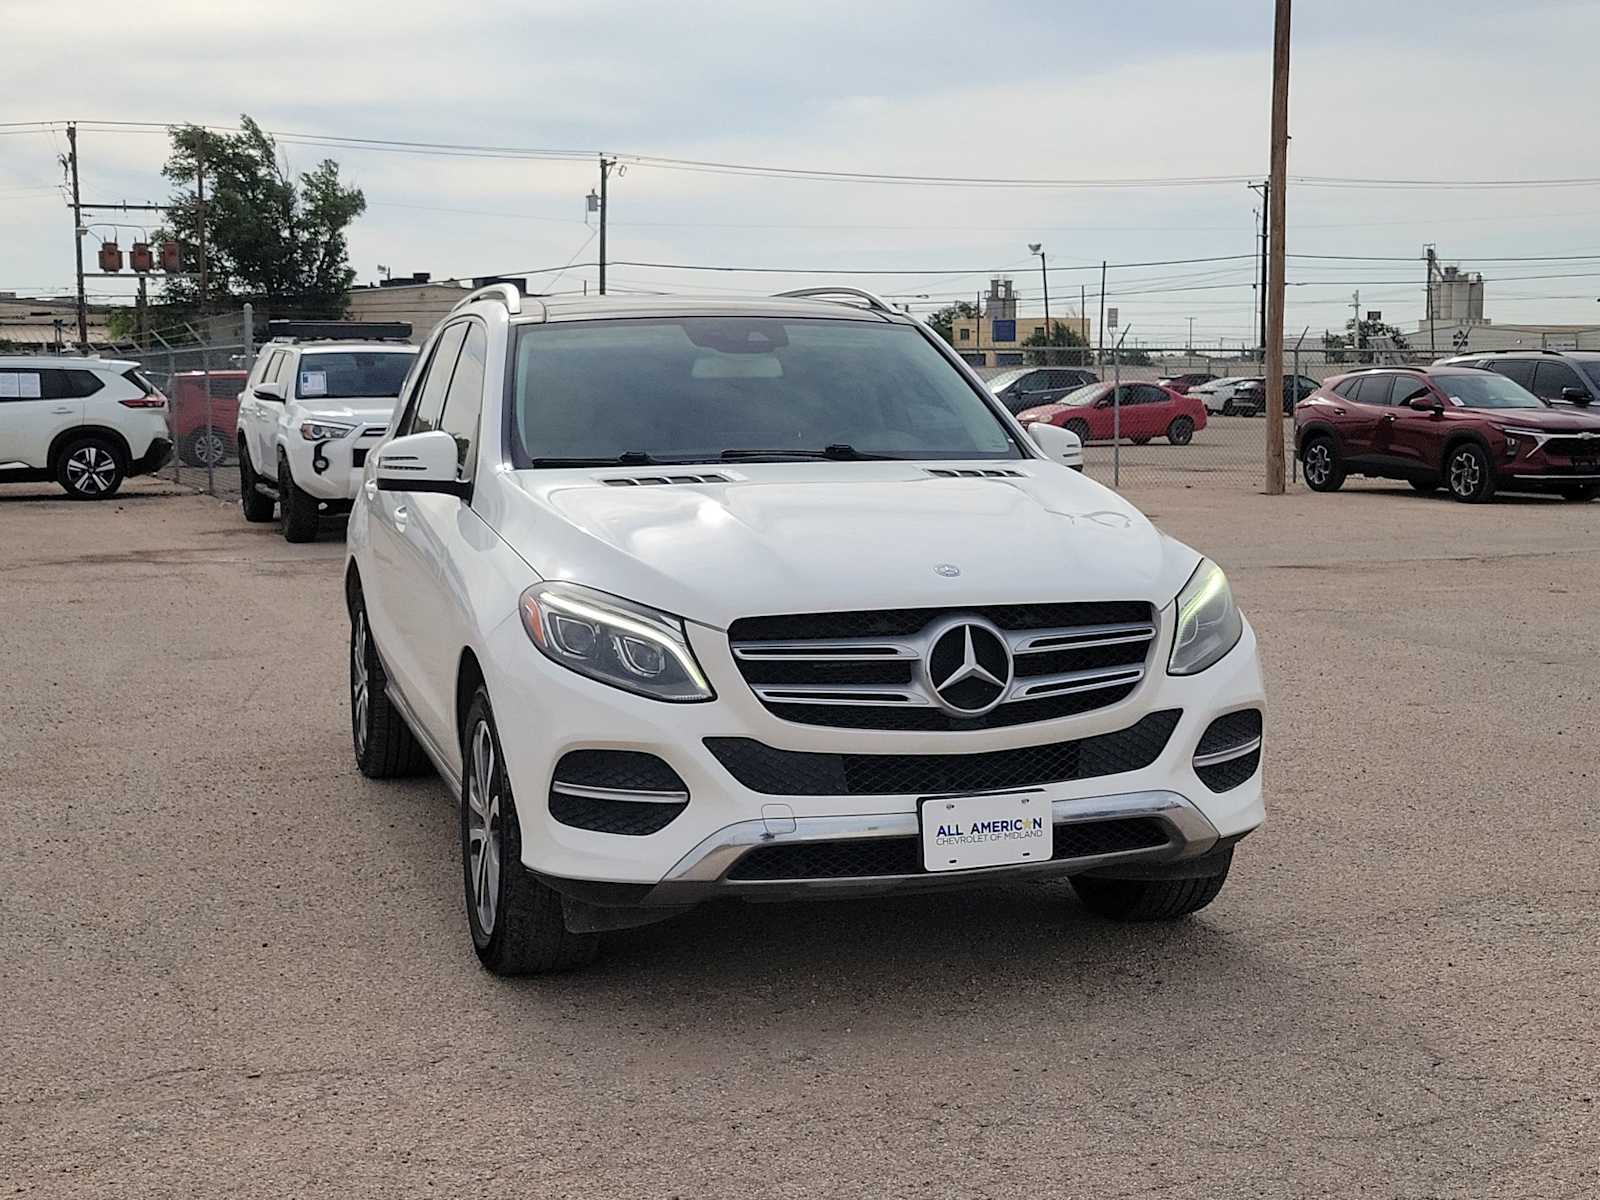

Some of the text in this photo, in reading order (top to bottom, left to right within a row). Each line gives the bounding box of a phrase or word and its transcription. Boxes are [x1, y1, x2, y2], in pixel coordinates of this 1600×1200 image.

[936, 824, 964, 838] ALL
[936, 829, 1043, 846] CHEVROLET OF MIDLAND
